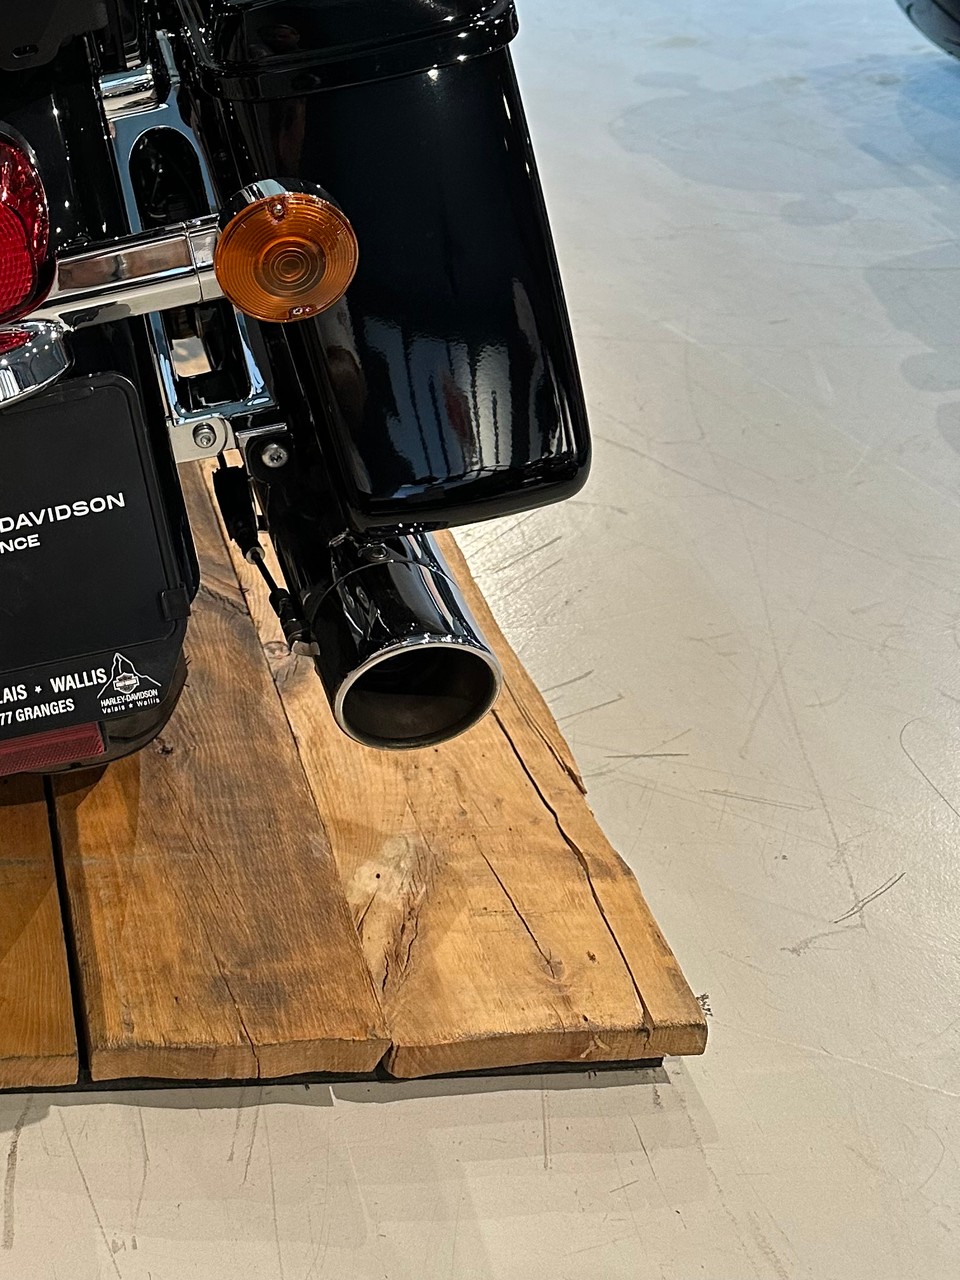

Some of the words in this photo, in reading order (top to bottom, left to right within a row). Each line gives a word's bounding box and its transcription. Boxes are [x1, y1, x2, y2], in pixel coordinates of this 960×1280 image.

[49, 668, 107, 693] WALLIS
[100, 689, 159, 707] HARLEY-DAVIDSON
[102, 705, 126, 714] Valais
[136, 697, 160, 707] Wallis
[16, 699, 75, 723] GRANGES
